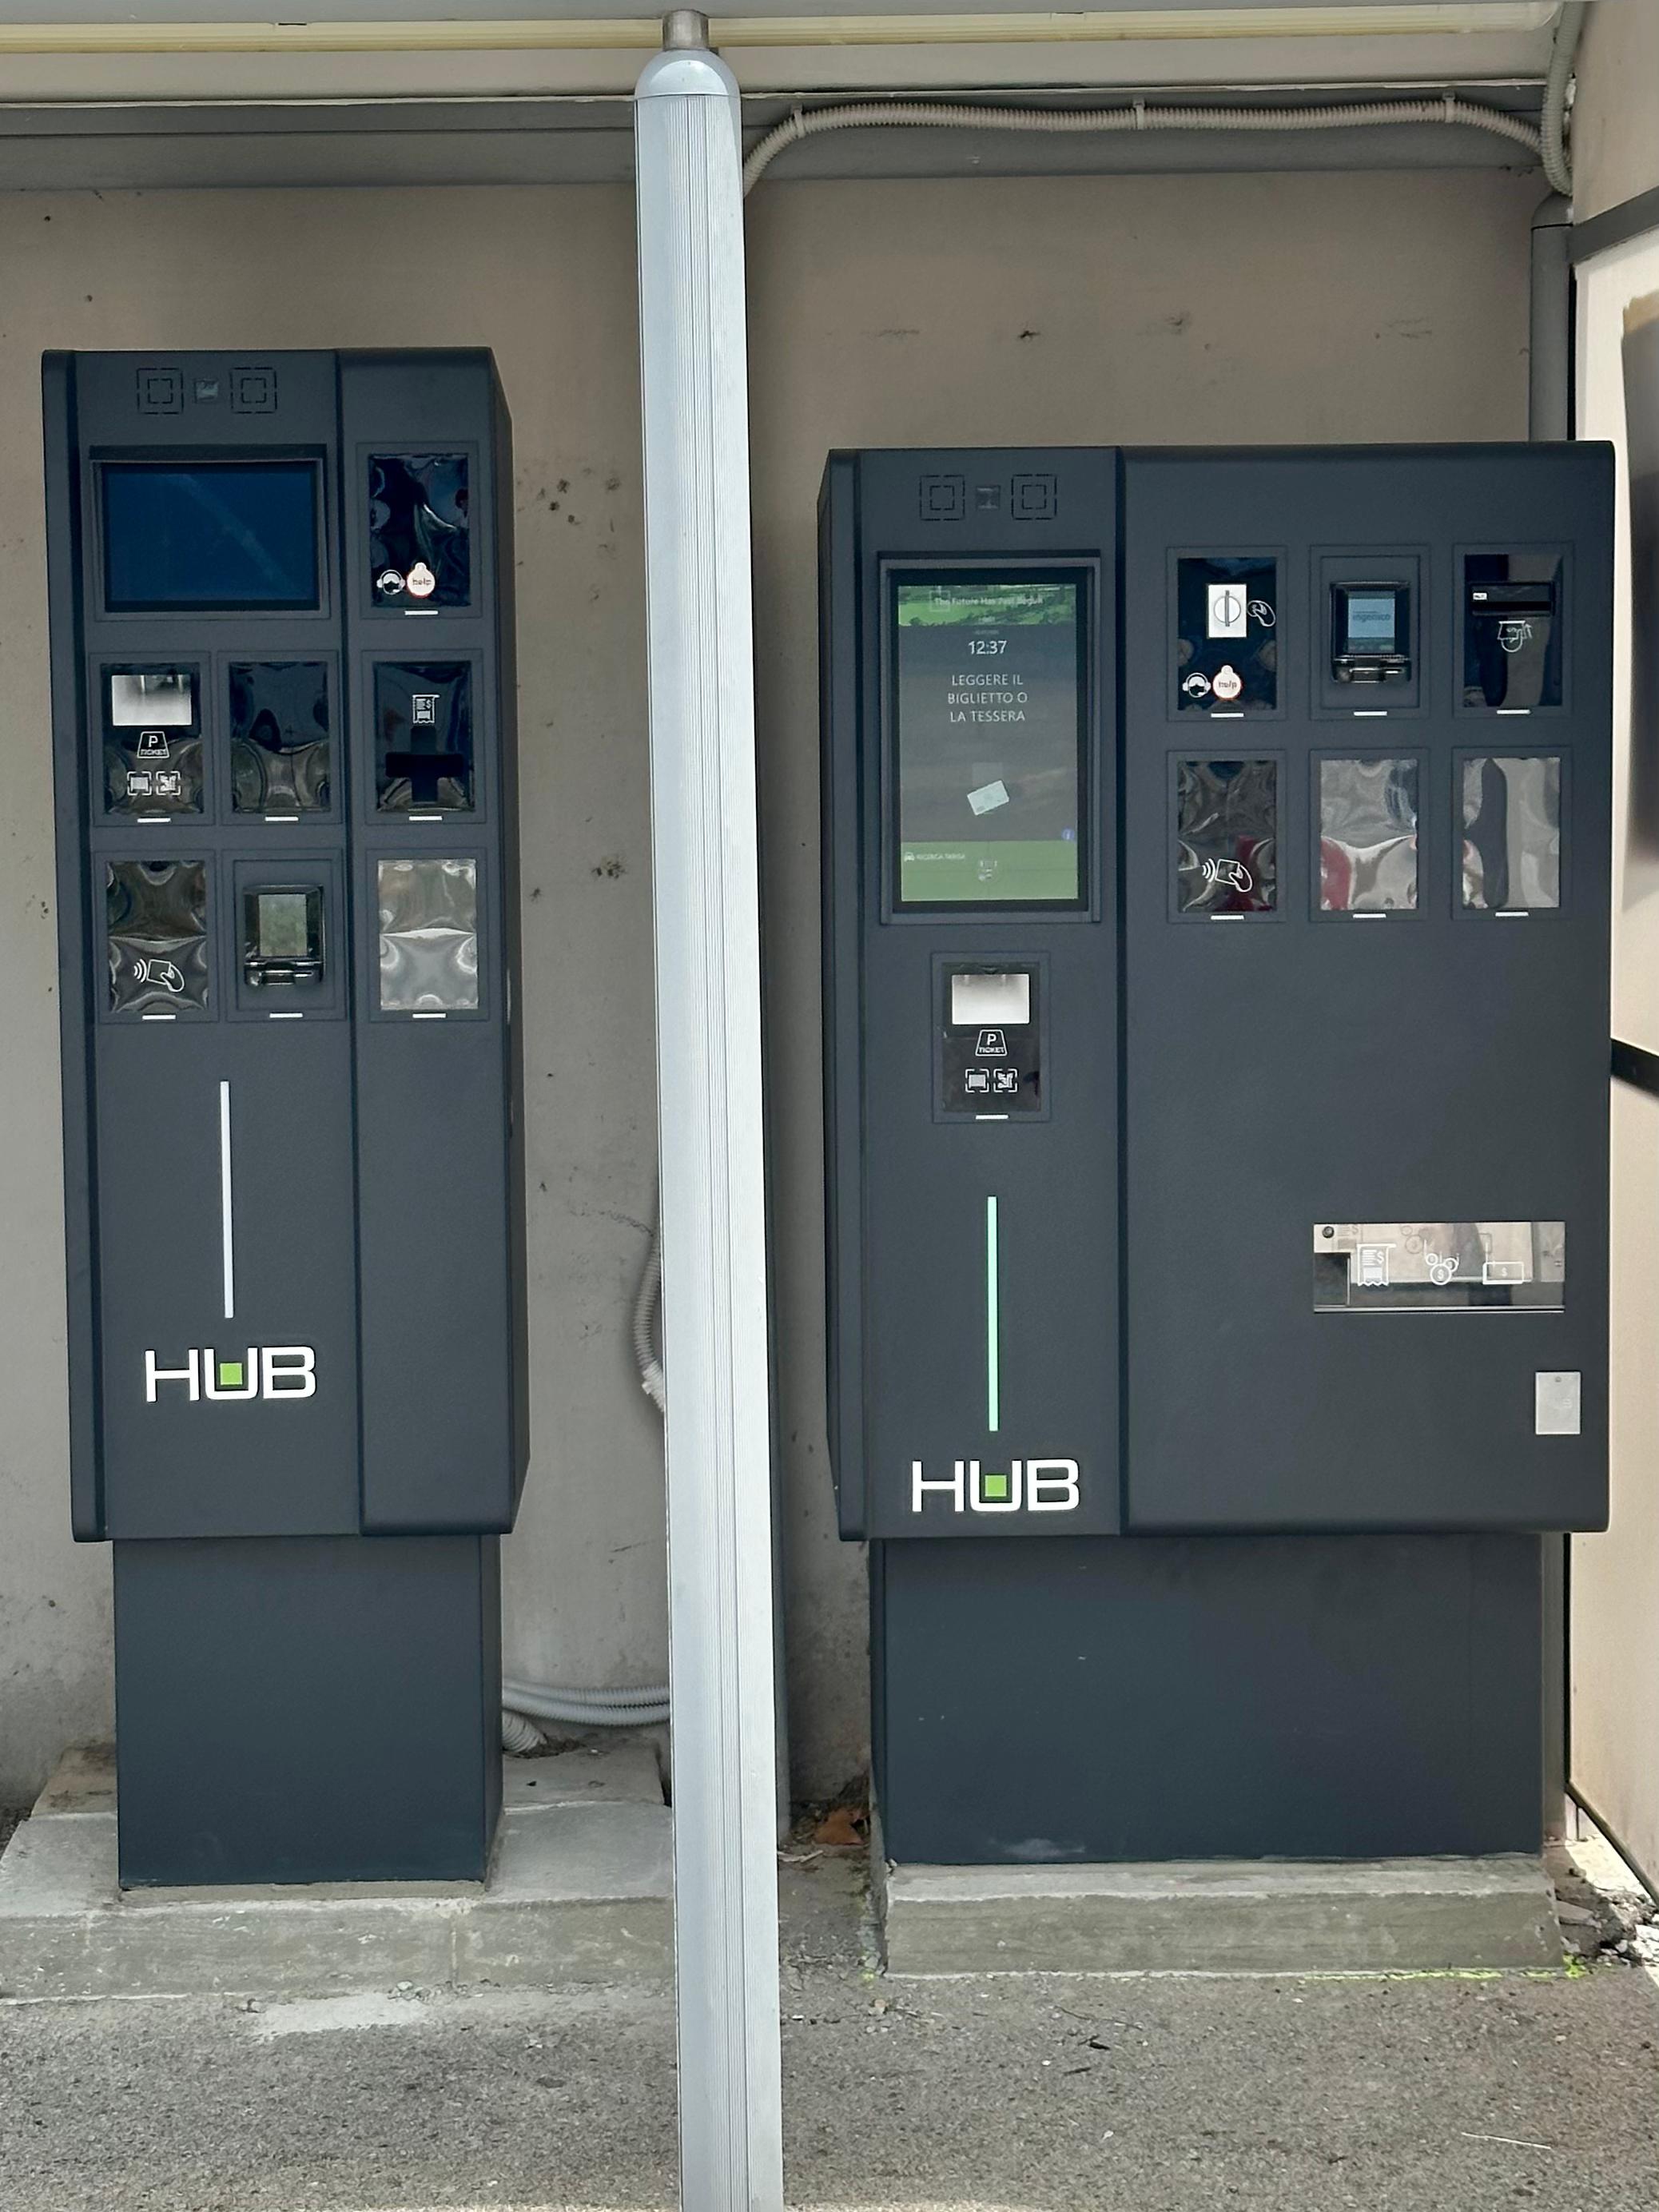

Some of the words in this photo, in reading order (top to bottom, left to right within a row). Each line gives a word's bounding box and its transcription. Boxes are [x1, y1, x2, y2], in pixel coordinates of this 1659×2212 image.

[969, 640, 1007, 654] 12:37
[952, 674, 1009, 686] LEGGERE
[1013, 674, 1024, 685] IL
[948, 692, 1013, 704] BIGLIETTO
[1017, 692, 1028, 703] O
[950, 710, 966, 722] LA
[969, 710, 1025, 722] TESSERA
[148, 735, 158, 747] P
[987, 1033, 997, 1045] P
[145, 1346, 316, 1402] HUB
[912, 1458, 1080, 1512] HUB
